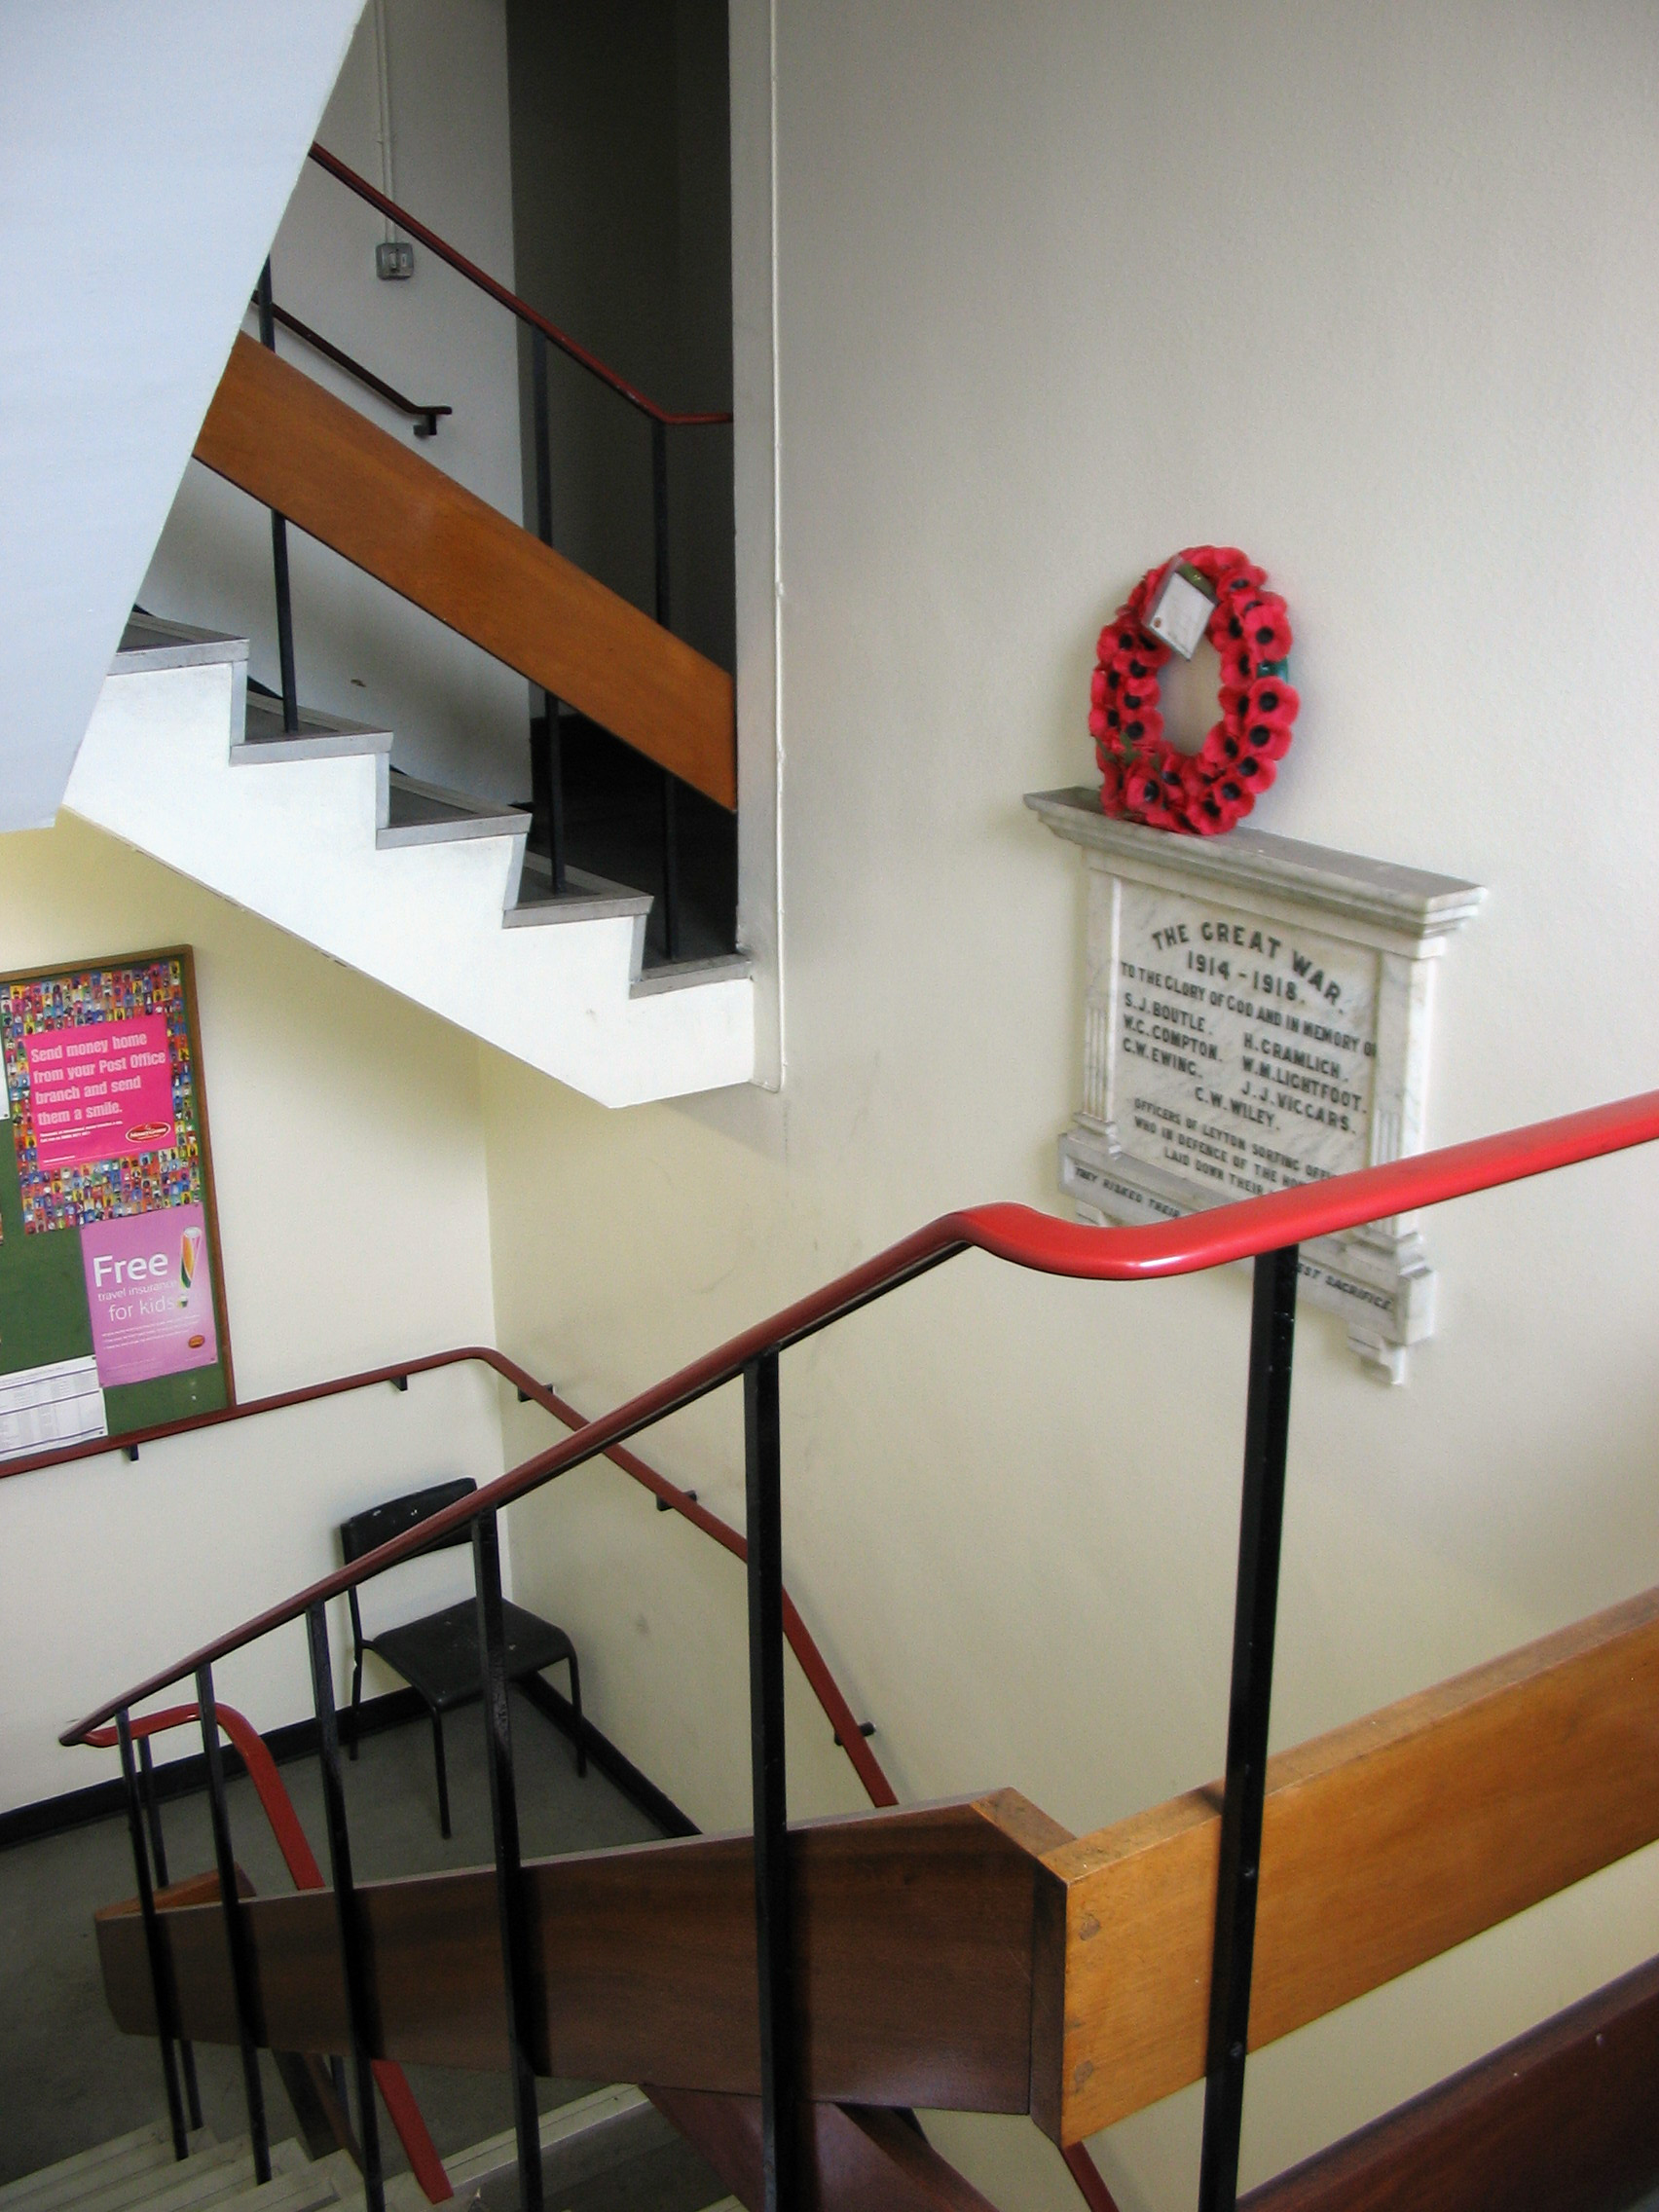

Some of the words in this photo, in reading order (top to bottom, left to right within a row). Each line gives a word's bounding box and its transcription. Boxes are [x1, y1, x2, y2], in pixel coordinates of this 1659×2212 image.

[1152, 923, 1189, 950] THE
[1201, 921, 1281, 958] GREAT
[1122, 961, 1135, 977] TO
[1138, 967, 1161, 986] THE
[1165, 976, 1205, 1002] GLORY
[1209, 991, 1225, 1005] OF
[1228, 996, 1253, 1016] GOD
[1257, 1007, 1281, 1026] AND
[1286, 1014, 1298, 1033] IN
[1304, 1020, 1360, 1051] MEMORY
[31, 1044, 62, 1063] Send
[66, 1037, 108, 1060] money
[113, 1032, 147, 1050] home
[34, 1069, 63, 1085] from
[68, 1062, 94, 1082] your
[99, 1057, 127, 1075] Post
[130, 1051, 166, 1070] Office
[35, 1086, 80, 1105] branch
[84, 1081, 107, 1097] and
[111, 1076, 141, 1092] send
[38, 1109, 69, 1125] them
[75, 1109, 82, 1120] a
[87, 1102, 123, 1119] smile.
[1134, 1097, 1180, 1125] OFFICERS
[1187, 1117, 1198, 1129] OF
[1202, 1124, 1246, 1150] LEYTON
[1252, 1144, 1300, 1170] SORTING
[1135, 1116, 1156, 1134] WHO
[1162, 1129, 1173, 1141] IN
[1178, 1136, 1227, 1162] DEFENCE
[1233, 1156, 1246, 1169] OF
[1254, 1163, 1276, 1182] THE
[1164, 1146, 1189, 1165] LAID
[1196, 1159, 1224, 1181] DOWN
[1229, 1173, 1264, 1195] THEIR
[1103, 1178, 1143, 1202] RISKED
[93, 1252, 168, 1287] Free
[97, 1288, 127, 1302] travel
[129, 1278, 177, 1296] insurance
[109, 1303, 133, 1322] for
